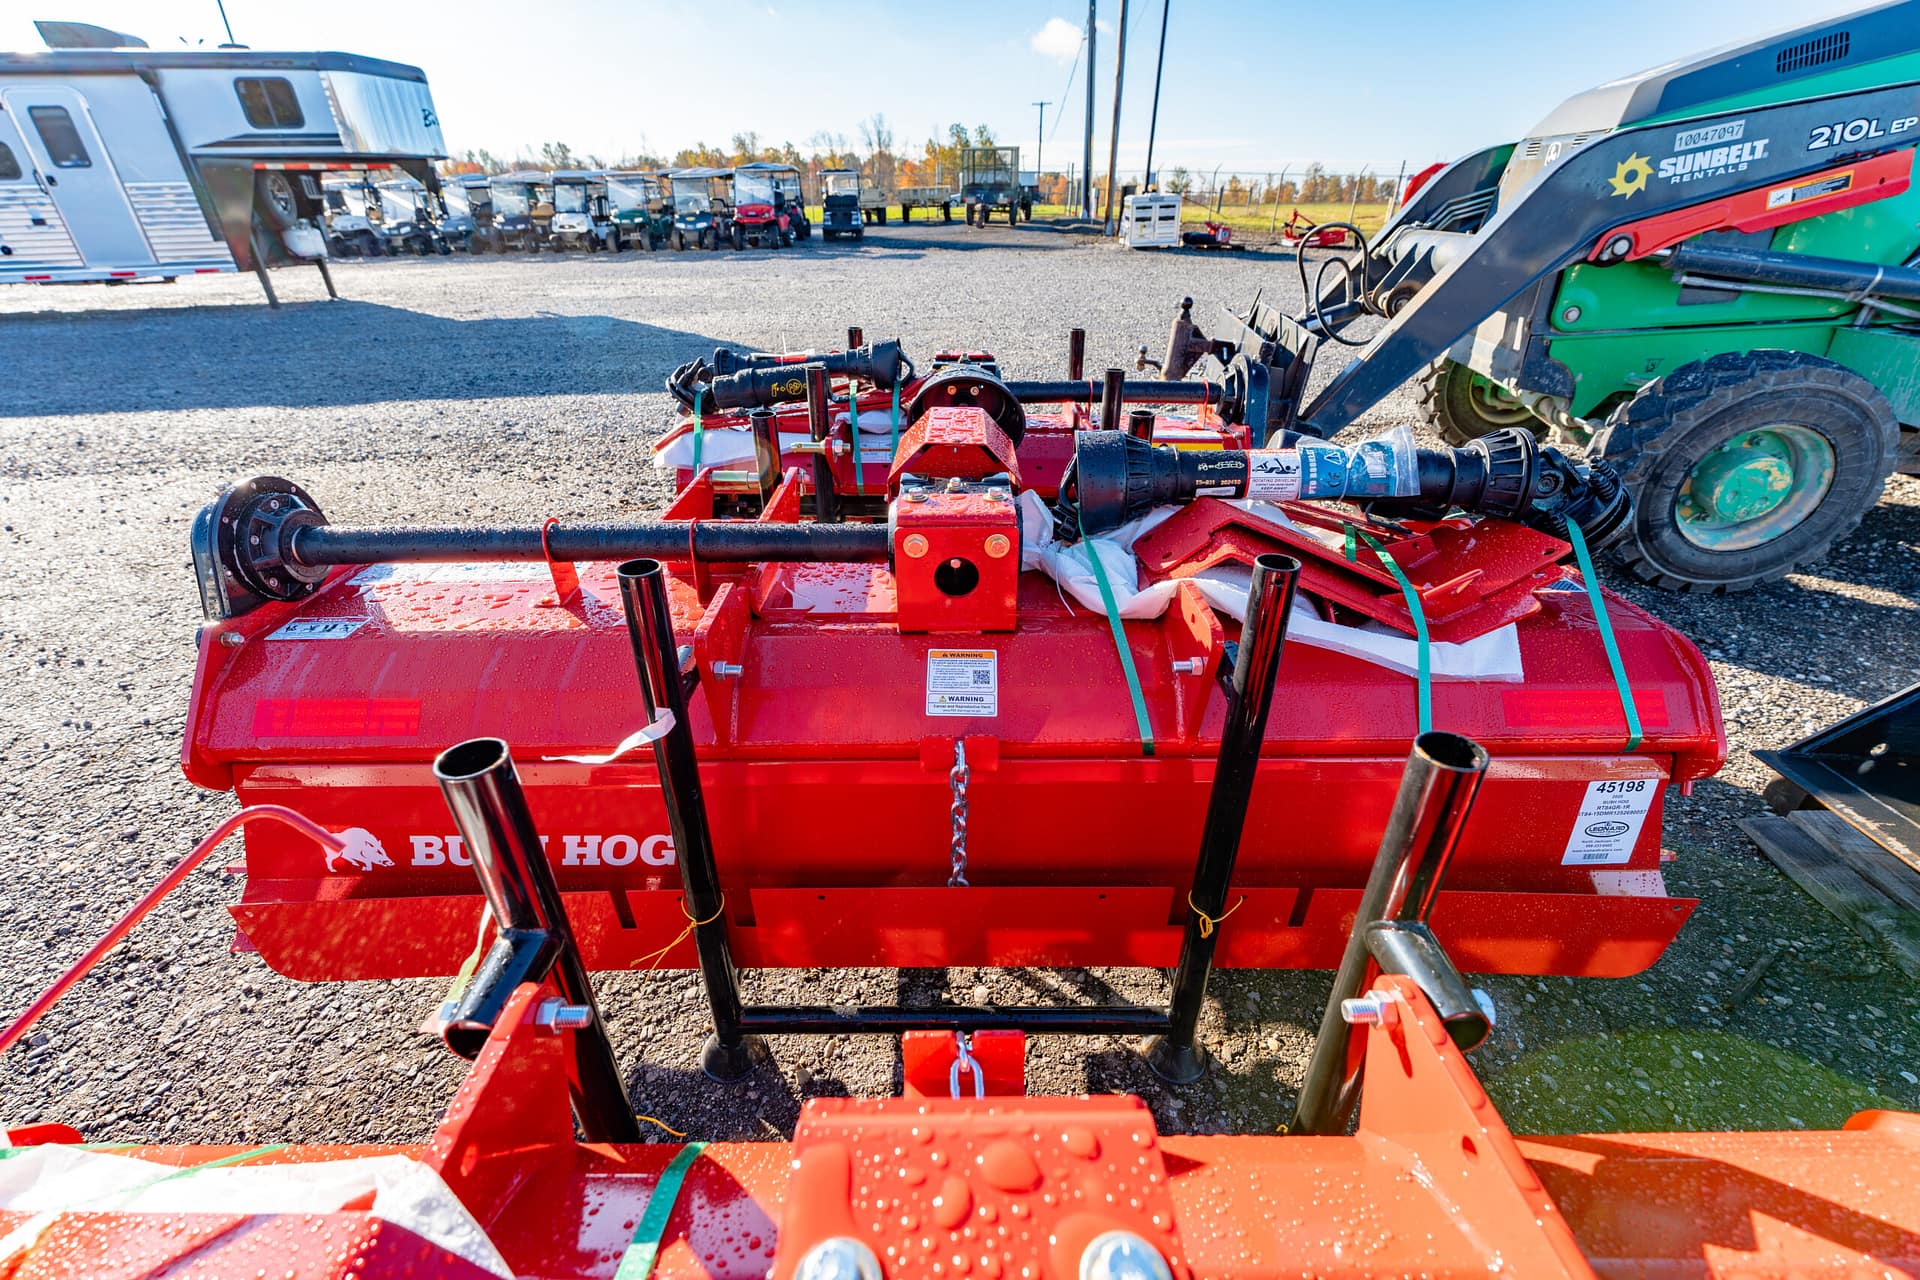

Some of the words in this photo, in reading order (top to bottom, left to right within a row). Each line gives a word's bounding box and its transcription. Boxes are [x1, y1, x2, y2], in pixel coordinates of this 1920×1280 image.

[1677, 124, 1743, 148] 10047097
[1807, 118, 1885, 151] 210L
[1889, 116, 1919, 134] EP
[1658, 138, 1769, 178] SUNBELT
[1670, 162, 1749, 185] RENTALS
[1596, 781, 1645, 793] 45198
[562, 834, 676, 866] HOG
